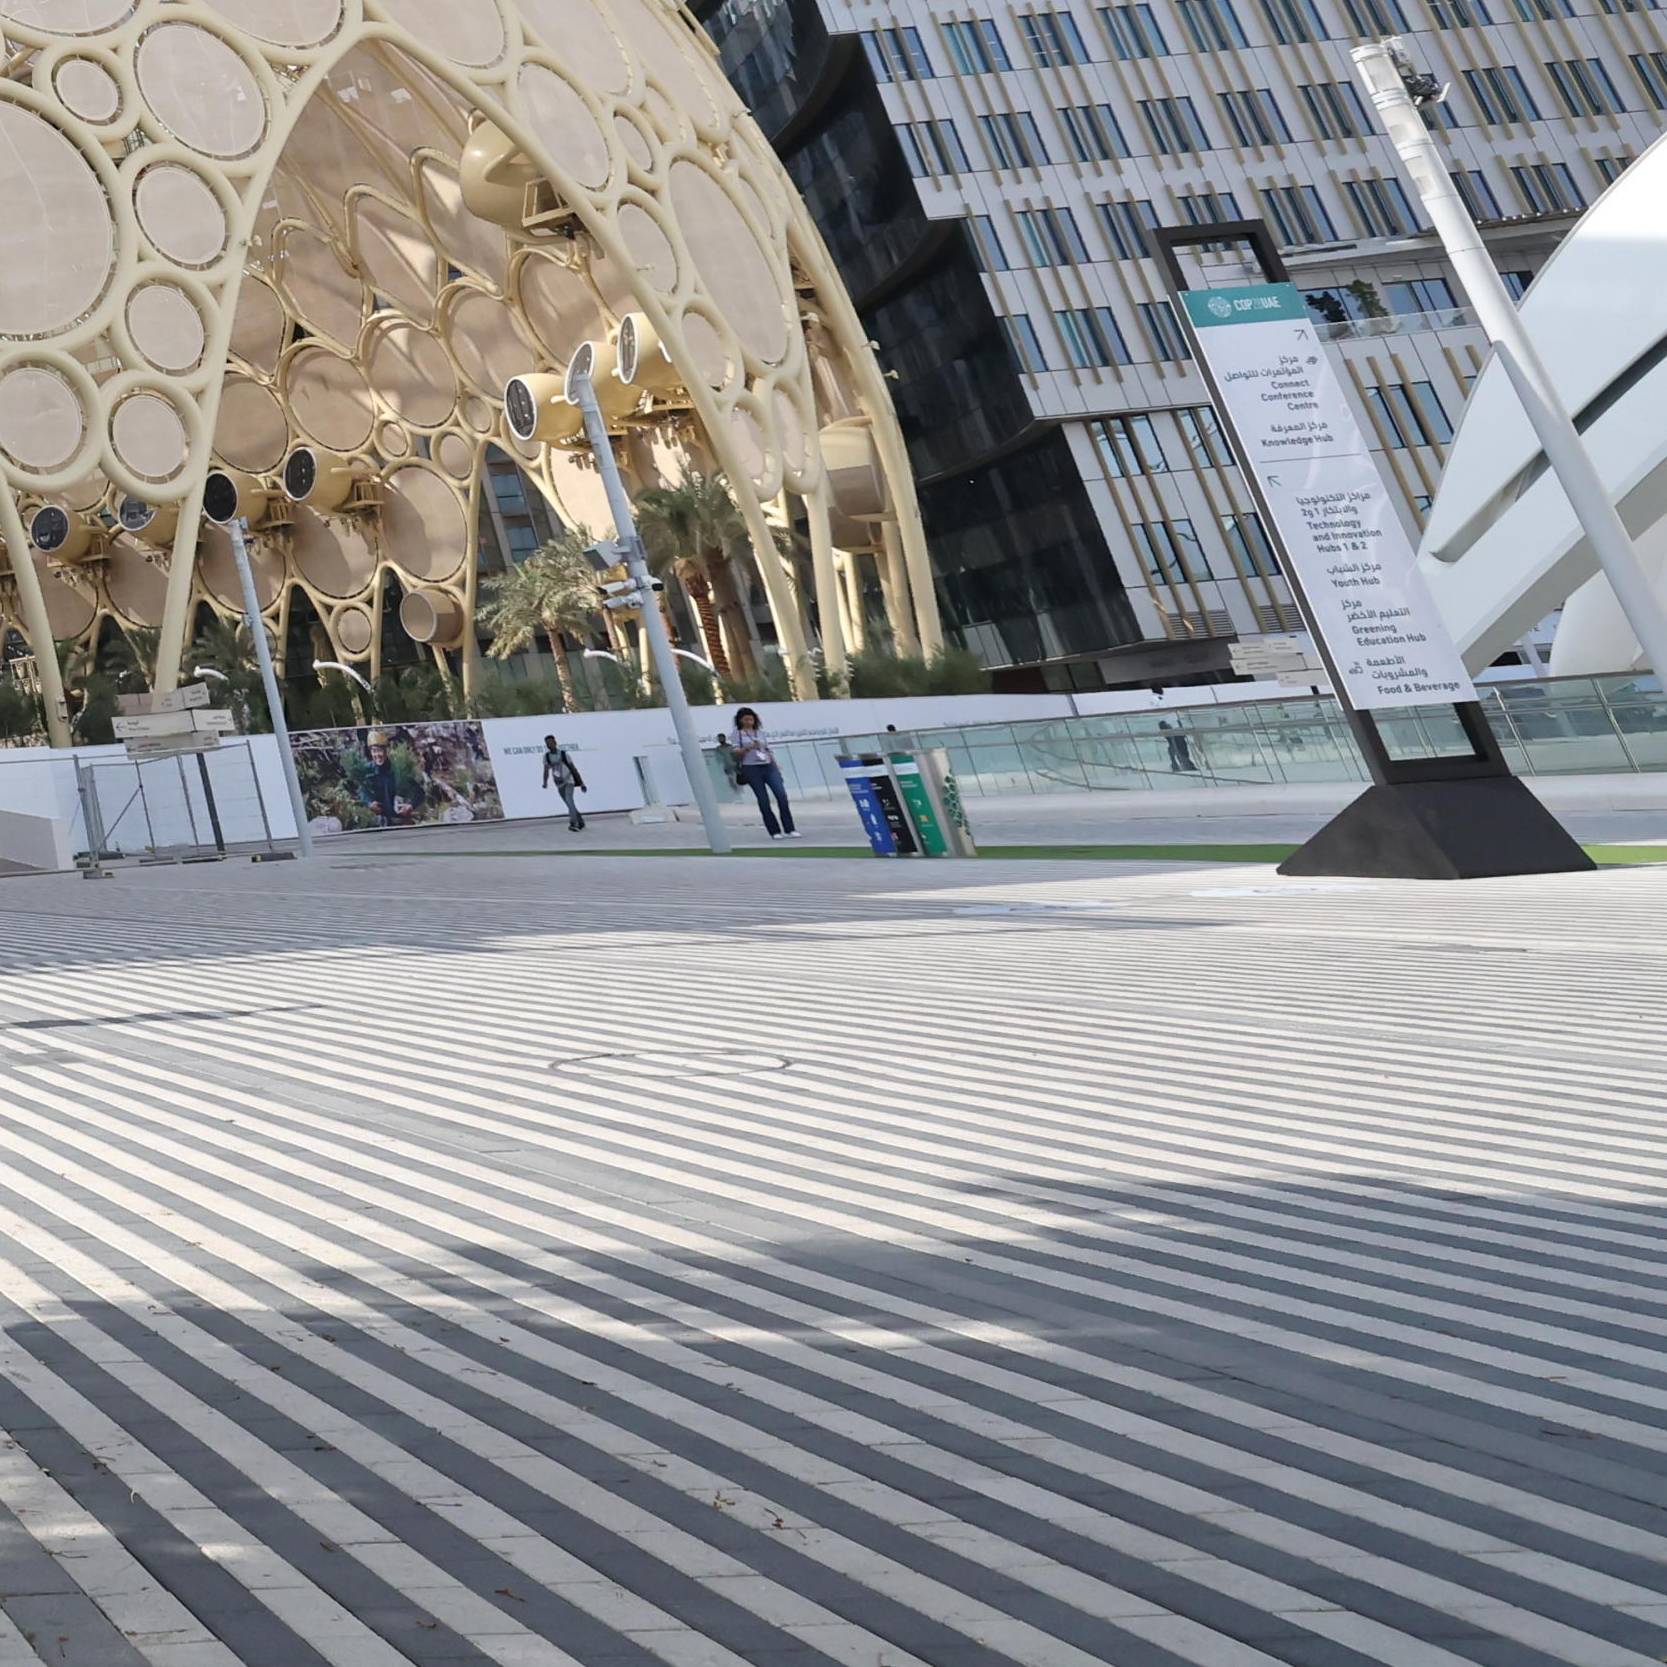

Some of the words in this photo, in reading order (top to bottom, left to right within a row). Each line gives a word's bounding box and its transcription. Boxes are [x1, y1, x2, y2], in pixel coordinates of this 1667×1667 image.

[1278, 355, 1299, 365] مركز
[1260, 366, 1304, 378] المؤتمرات
[1271, 380, 1310, 389] Connect
[1261, 391, 1314, 402] Conference
[1287, 401, 1319, 410] Centre
[1271, 423, 1306, 434] المعرفة
[1308, 422, 1328, 432] مركز
[1261, 436, 1314, 447] Knowledge
[1314, 434, 1334, 442] Hub
[1296, 493, 1346, 505] التكنولوجيا
[1347, 492, 1371, 502] مراكز
[1306, 519, 1361, 530] Technology
[1312, 533, 1330, 541] and
[1331, 529, 1382, 540] Innovation
[1316, 544, 1342, 553] Hubs
[1351, 542, 1359, 550] &
[1360, 541, 1368, 550] 2
[1326, 563, 1360, 575] الشباب
[1361, 562, 1381, 573] مركز
[1331, 578, 1359, 588] Youth
[1360, 576, 1380, 585] Hub
[1341, 599, 1362, 610] مركز
[1379, 607, 1411, 621] التعليم
[1352, 623, 1397, 634] Greening
[1357, 635, 1406, 646] Education
[1406, 633, 1427, 642] Hub
[1371, 667, 1428, 680] والمشروبات
[1377, 685, 1402, 695] Food
[1404, 684, 1412, 693] &
[1413, 681, 1460, 692] Beverage
